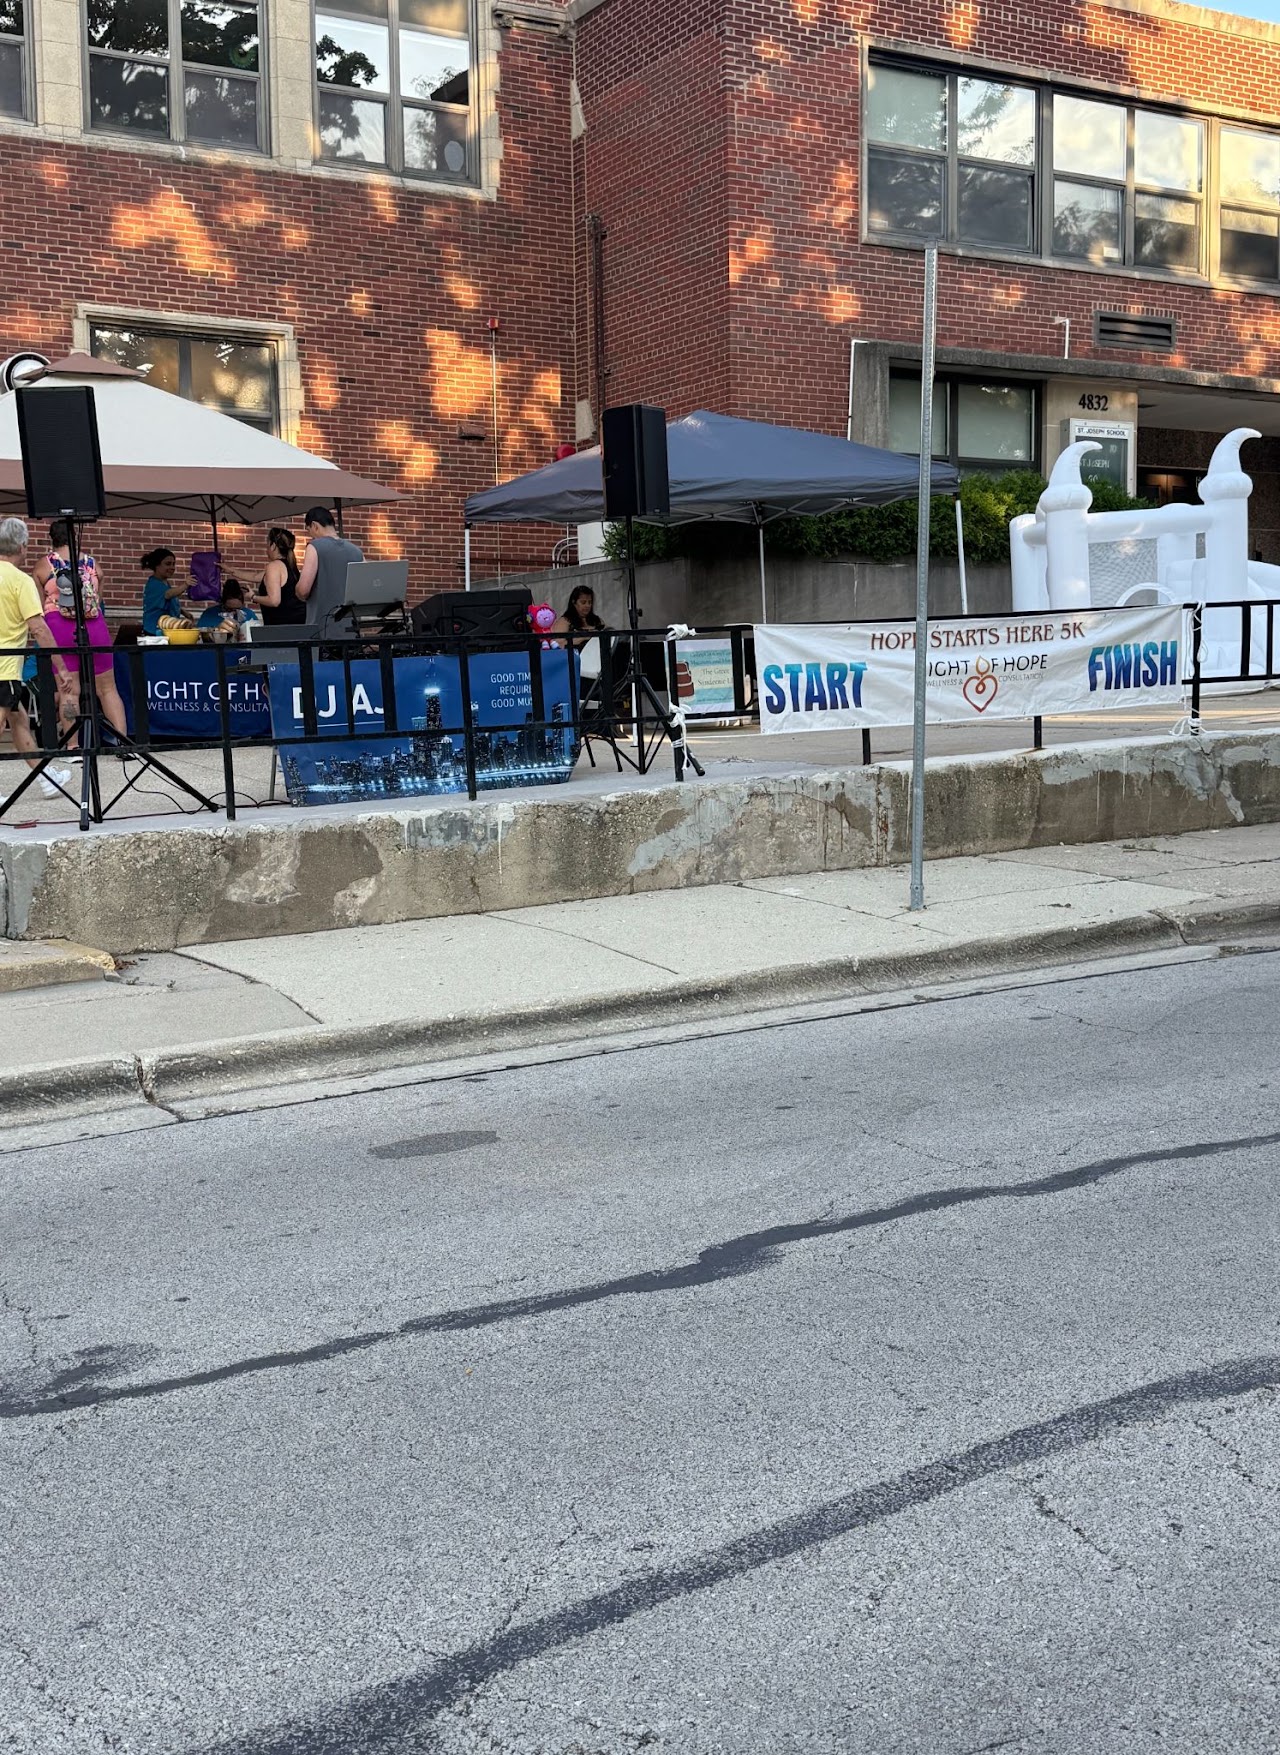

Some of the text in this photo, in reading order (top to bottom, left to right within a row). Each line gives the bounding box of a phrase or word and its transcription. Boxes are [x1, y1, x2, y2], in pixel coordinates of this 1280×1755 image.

[1079, 393, 1109, 411] 4832
[930, 627, 1000, 648] STARTS
[1006, 624, 1054, 644] HERE
[1060, 621, 1085, 640] 5K
[928, 660, 970, 677] IGHT
[1003, 654, 1048, 672] HOPE
[1088, 640, 1178, 692] FINISH
[490, 672, 531, 683] GOOD TIM
[998, 672, 1044, 682] CONSULTATION
[147, 681, 203, 699] IGHT
[763, 662, 868, 714] START
[147, 702, 200, 712] WELLNESS
[202, 702, 211, 712] &
[491, 698, 515, 709] GOOD
